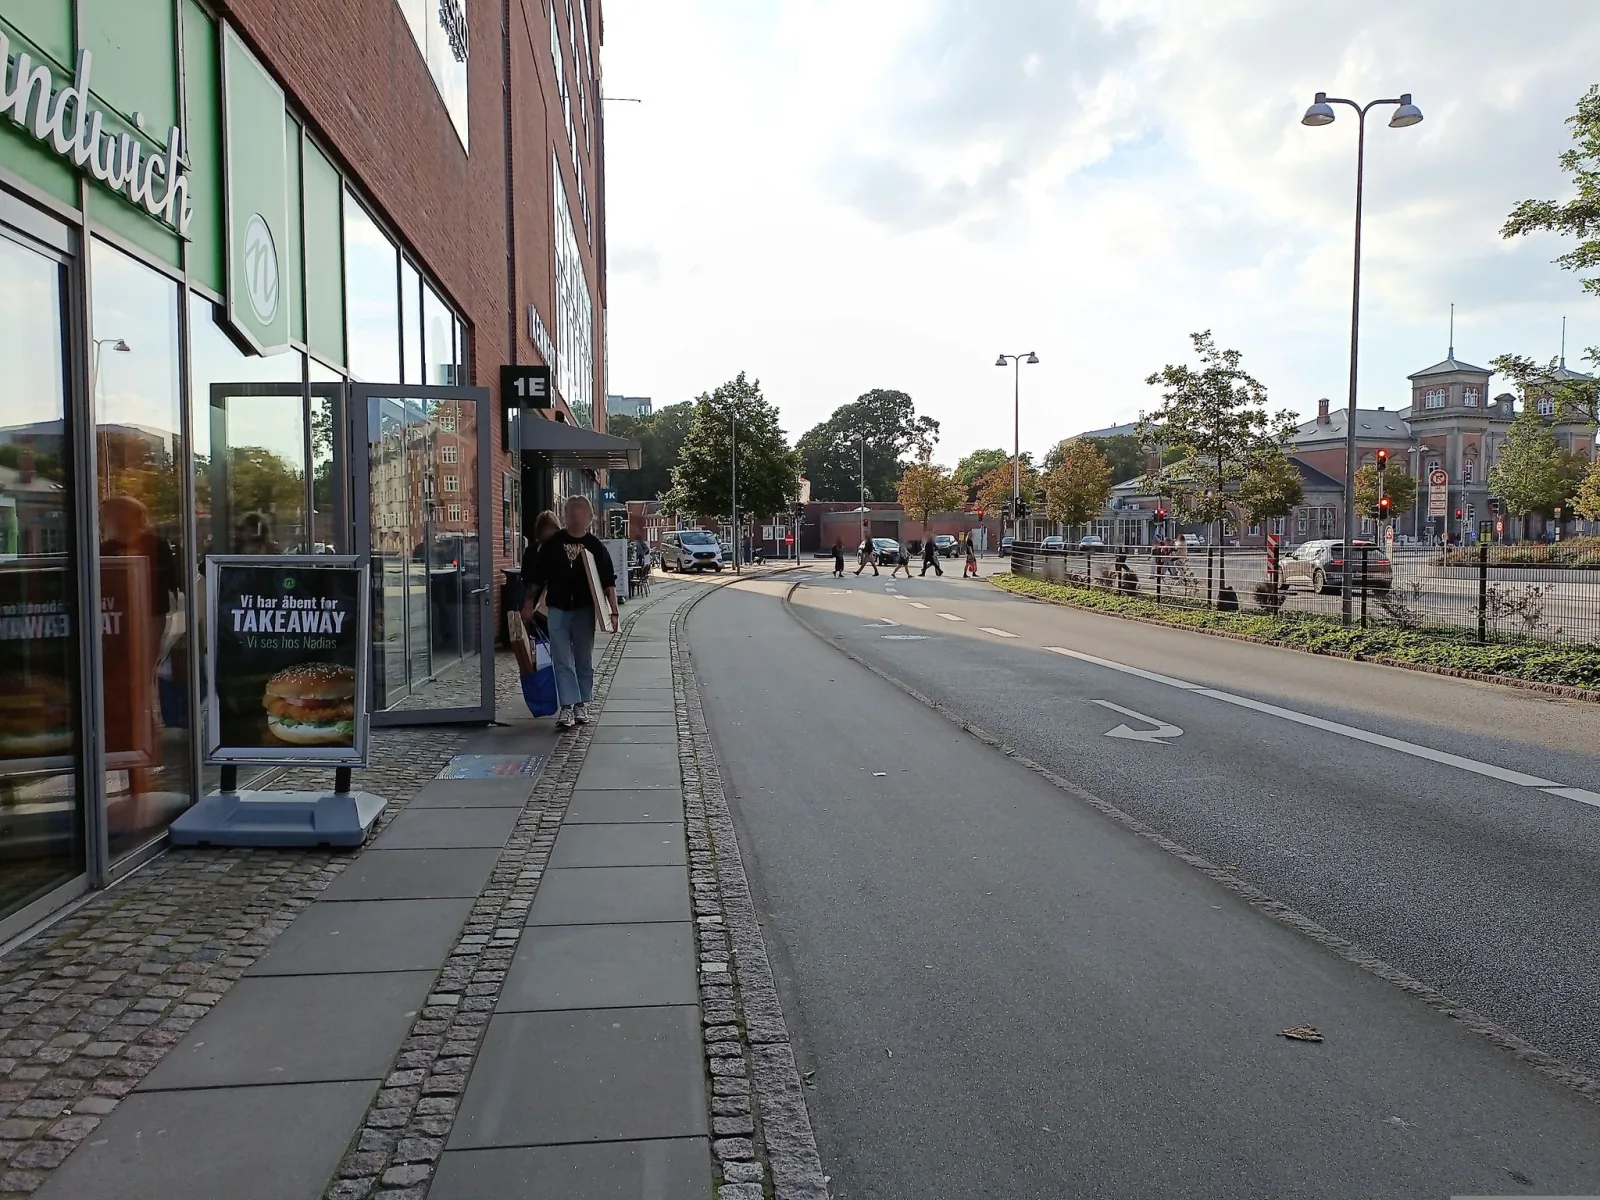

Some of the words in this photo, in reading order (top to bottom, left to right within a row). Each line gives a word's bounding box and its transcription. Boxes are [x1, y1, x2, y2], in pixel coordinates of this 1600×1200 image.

[513, 377, 546, 396] 1E
[240, 594, 253, 608] Vi
[257, 595, 278, 609] har
[282, 595, 317, 609] åbent
[321, 597, 338, 609] for
[231, 609, 346, 634] TAKEAWAY
[247, 636, 257, 648] Vi
[261, 638, 278, 649] ses
[281, 636, 300, 649] hos
[303, 636, 337, 649] Nadias
